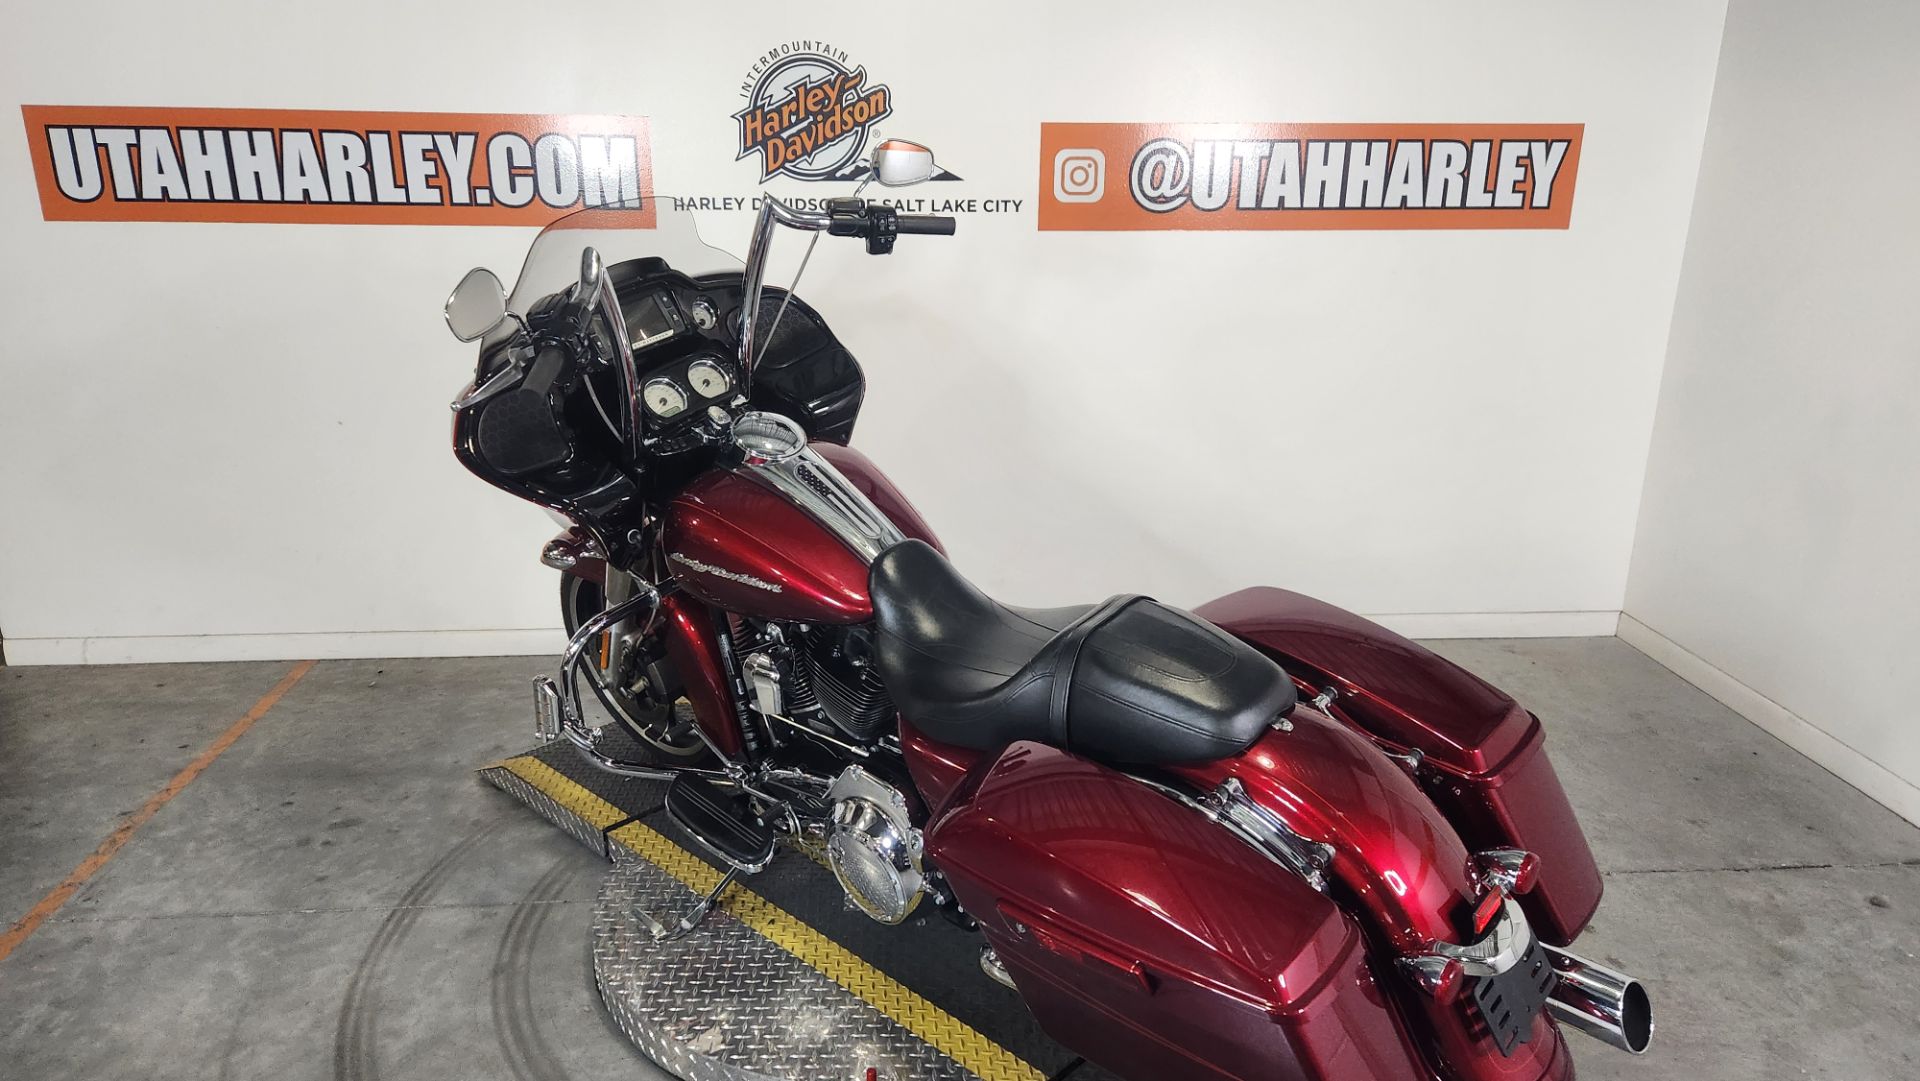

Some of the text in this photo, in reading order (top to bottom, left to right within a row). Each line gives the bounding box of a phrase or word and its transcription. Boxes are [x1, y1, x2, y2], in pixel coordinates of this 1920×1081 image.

[740, 40, 849, 98] INTERMOUNTAIN
[744, 72, 862, 148] Harley-
[766, 88, 886, 174] Davidson
[45, 124, 643, 210] UTAHHARLEY.COM
[674, 197, 745, 211] HARLEY
[932, 199, 977, 212] LAKE
[983, 199, 1023, 212] CITY
[1129, 136, 1571, 214] @UTAHHARLEY
